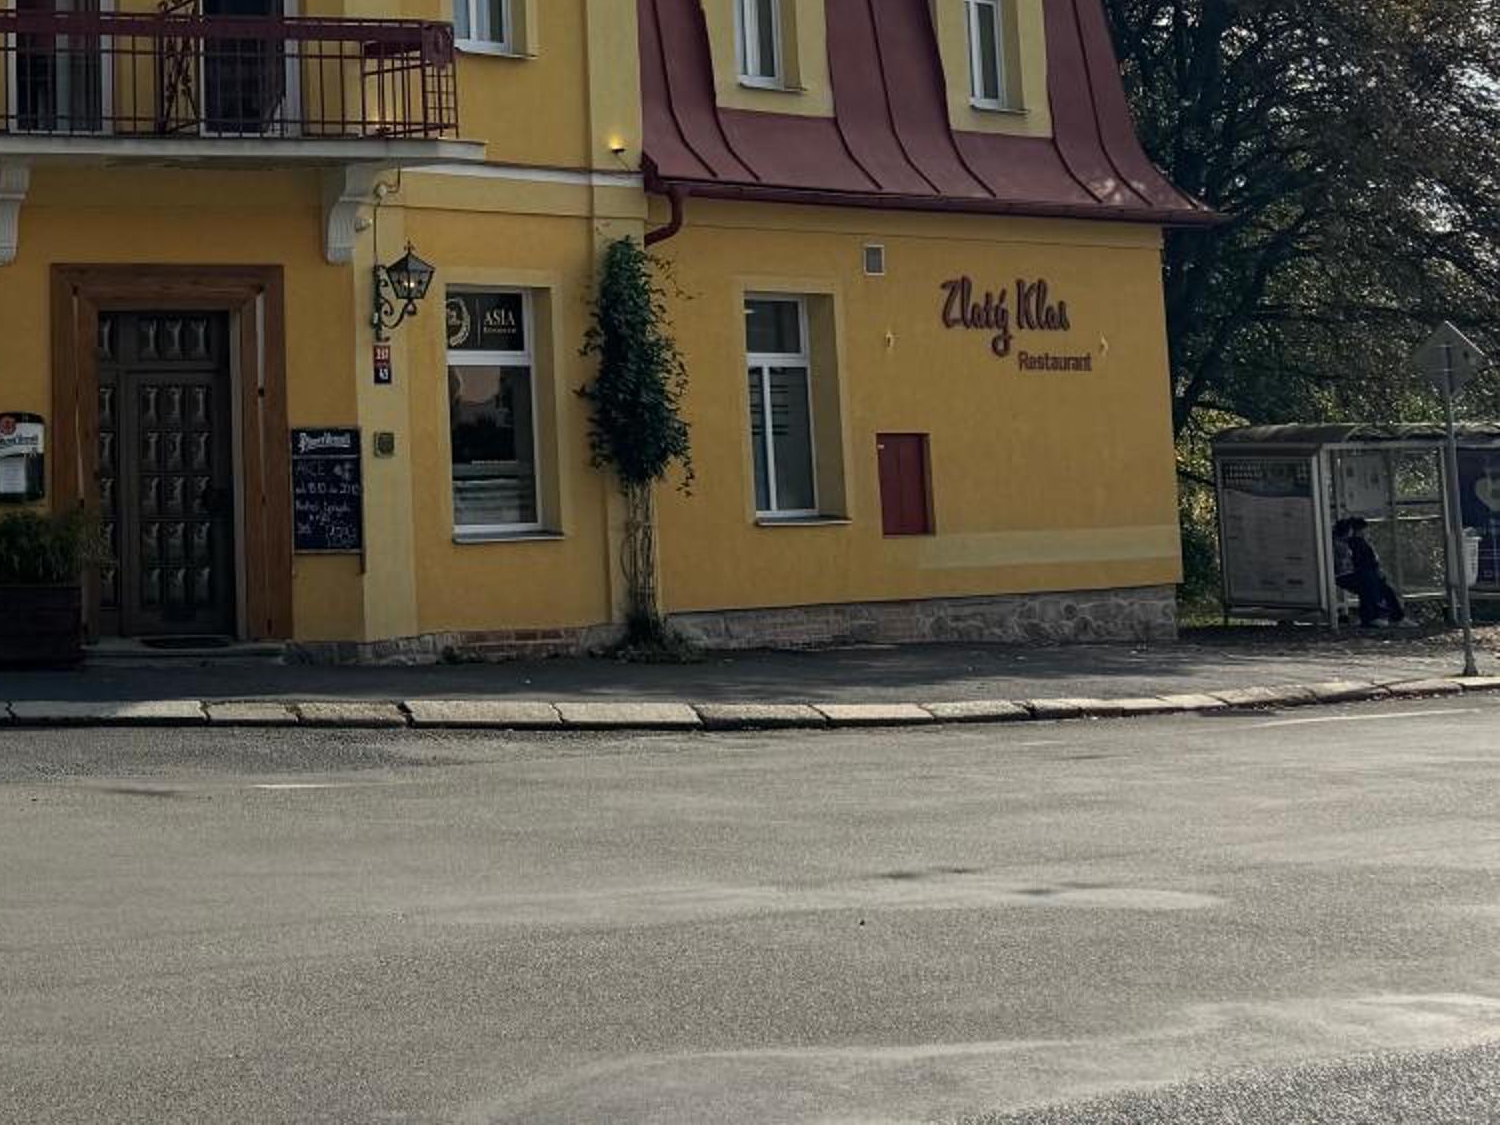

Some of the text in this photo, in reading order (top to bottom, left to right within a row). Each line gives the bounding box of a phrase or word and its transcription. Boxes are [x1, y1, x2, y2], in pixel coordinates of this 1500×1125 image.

[484, 307, 516, 326] ASIA
[940, 276, 1071, 357] Zlatý Klas
[1018, 351, 1093, 372] Restaurant
